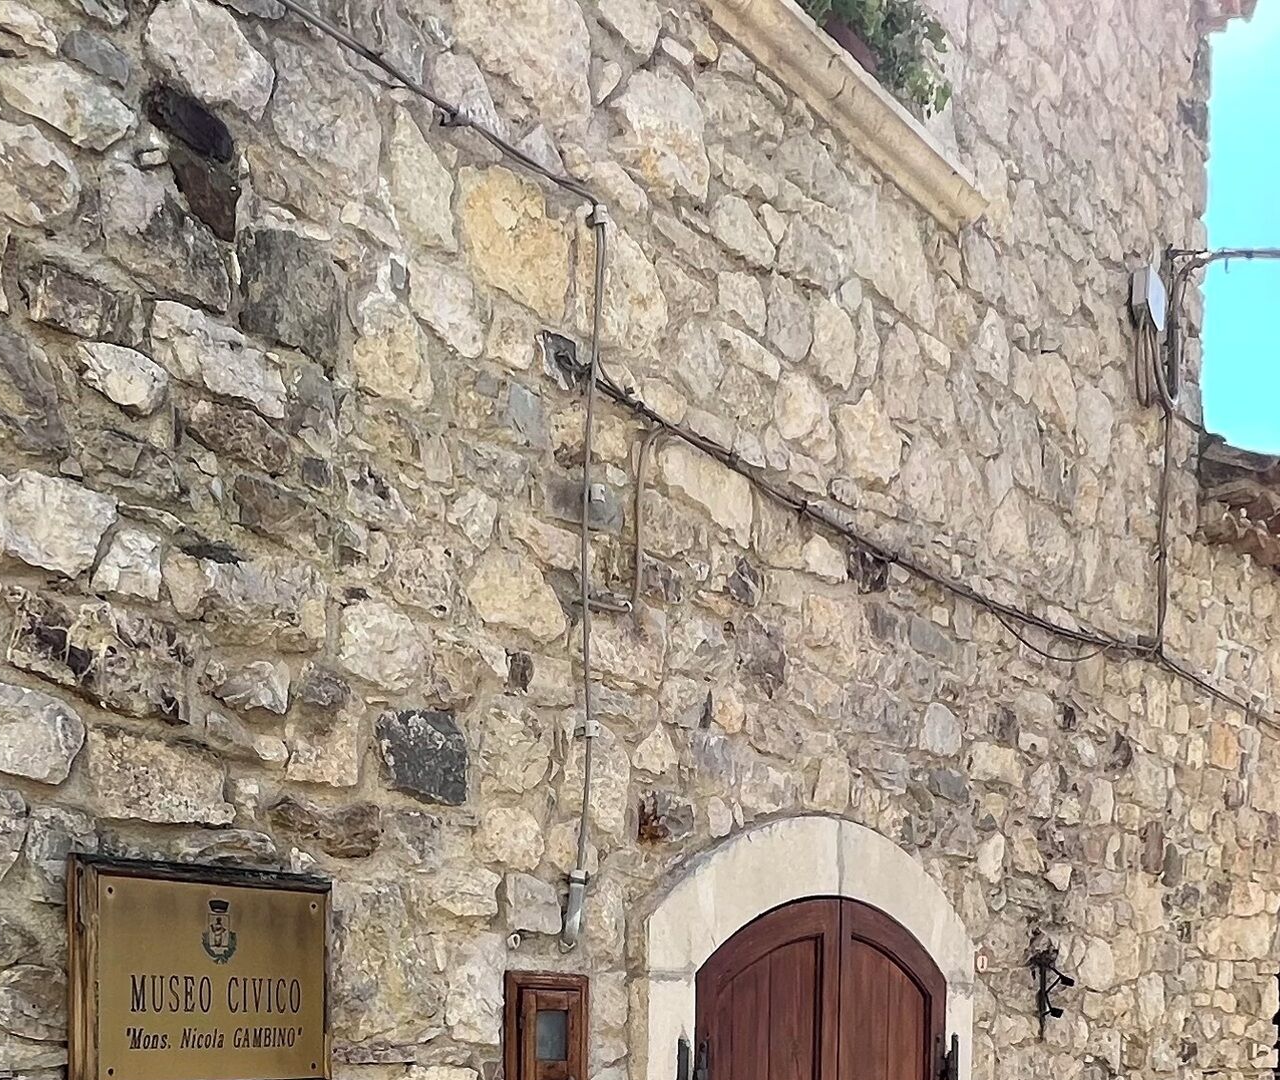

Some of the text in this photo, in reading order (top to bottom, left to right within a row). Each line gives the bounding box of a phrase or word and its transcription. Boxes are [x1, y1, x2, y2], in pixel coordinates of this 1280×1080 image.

[130, 975, 301, 1013] MUSEO CIVICO
[180, 1028, 224, 1048] Nicola
